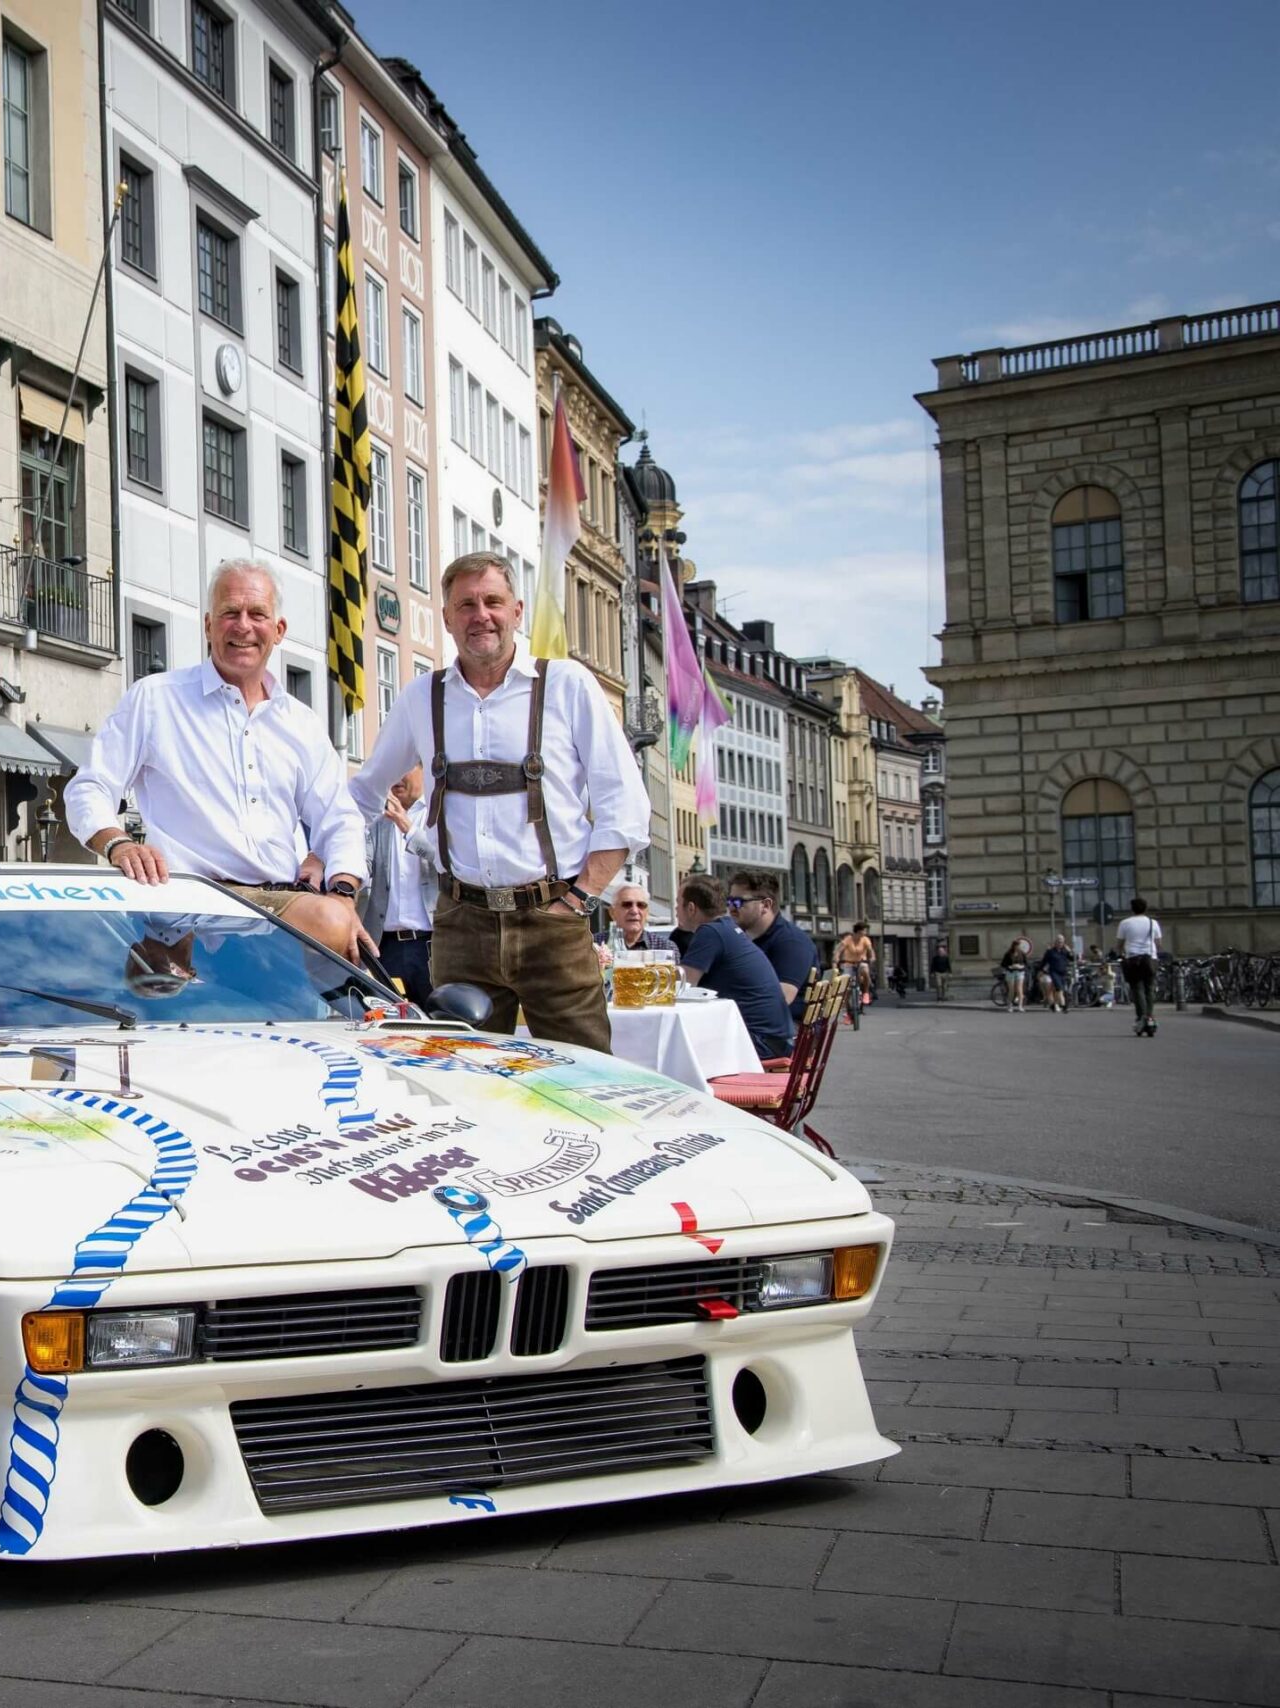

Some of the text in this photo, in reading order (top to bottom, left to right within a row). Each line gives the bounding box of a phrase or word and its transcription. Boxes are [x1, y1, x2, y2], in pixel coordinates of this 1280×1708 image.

[492, 1141, 596, 1193] SPATENHAUS
[549, 1186, 617, 1225] Sankt
[653, 1132, 726, 1160] Mühle
